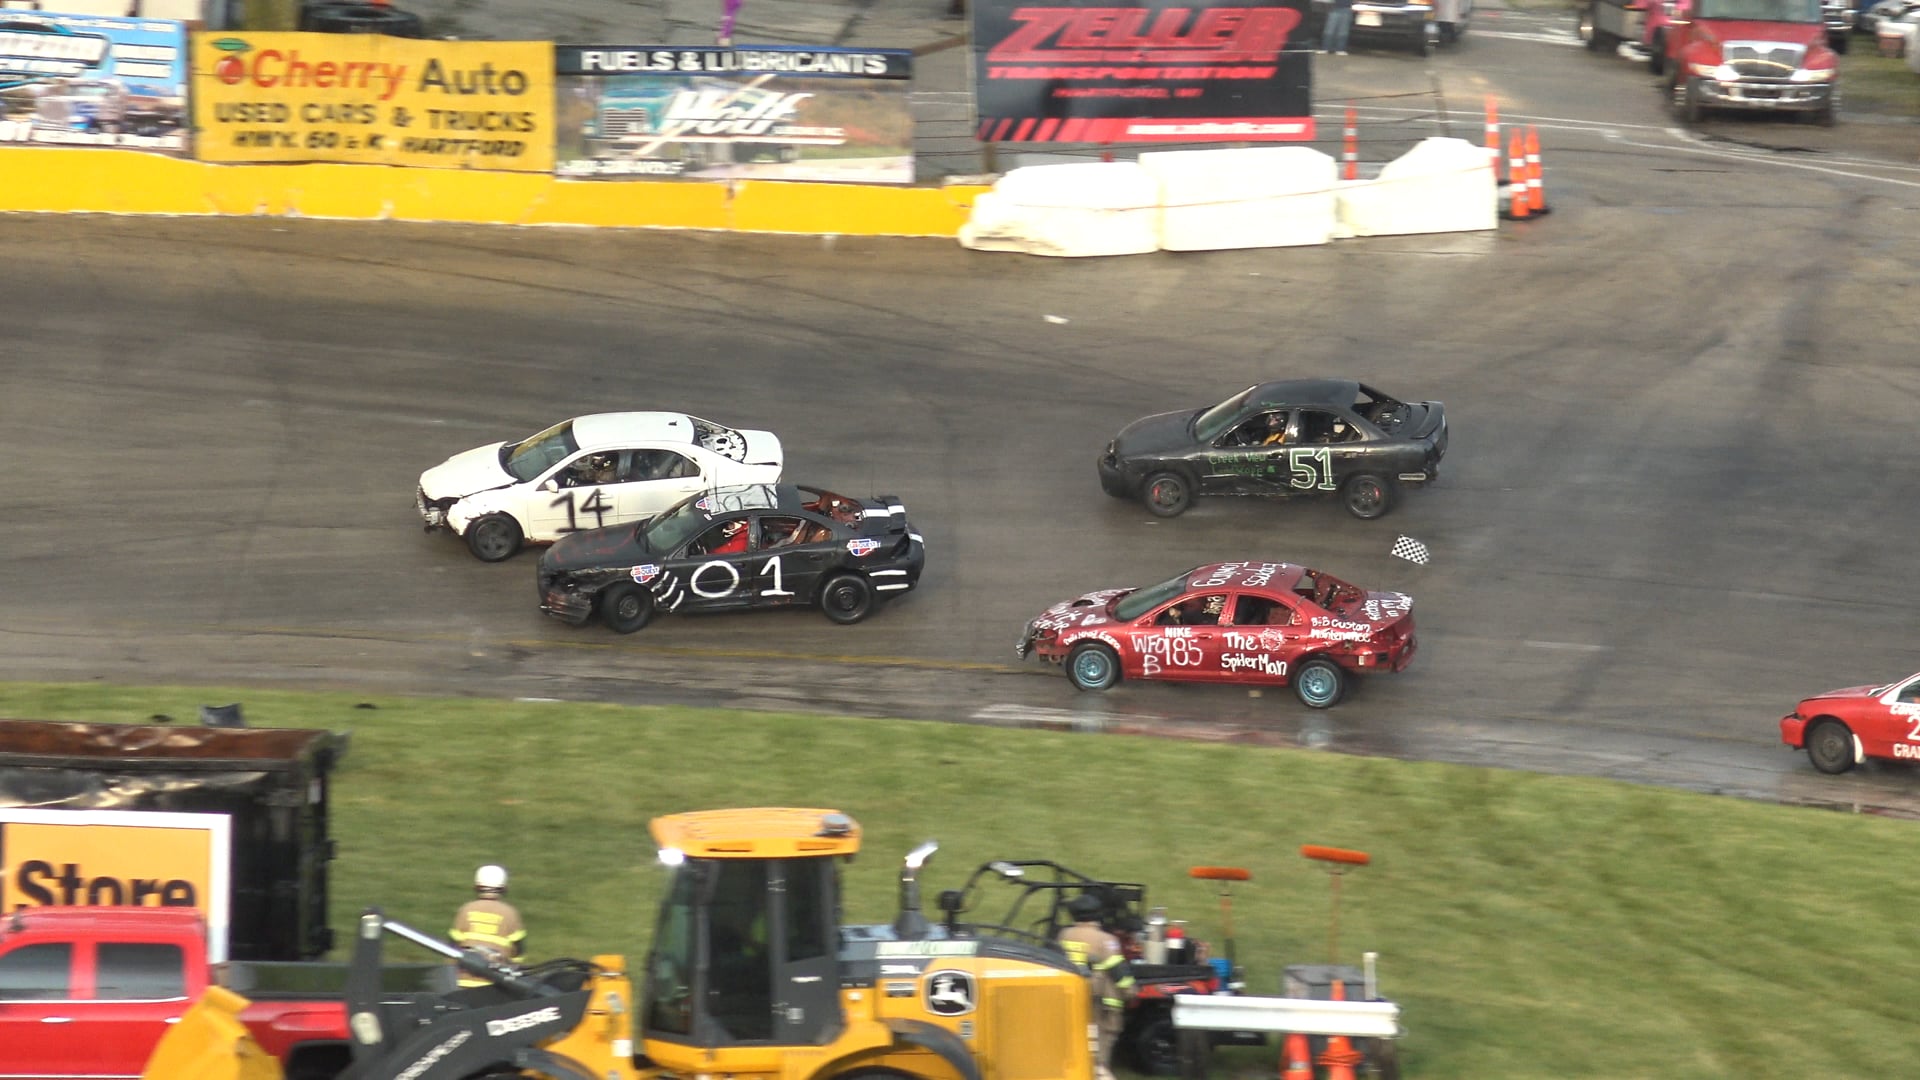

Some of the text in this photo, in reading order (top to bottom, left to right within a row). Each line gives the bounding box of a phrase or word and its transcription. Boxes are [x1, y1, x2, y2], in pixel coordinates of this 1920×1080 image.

[986, 8, 1301, 61] ZELLER
[252, 49, 528, 100] Cherry Auto
[581, 51, 888, 74] FUELS & LUBRICANTS
[987, 66, 1278, 80] TRANSPORTATION
[214, 102, 537, 132] USED CARS & TRUCKS
[306, 130, 340, 149] 60
[401, 136, 527, 157] HARTFORD
[1289, 447, 1336, 491] 51
[550, 488, 613, 534] 14
[1164, 627, 1192, 639] NIKE
[1221, 630, 1259, 651] The
[1143, 654, 1163, 676] B
[18, 860, 197, 907] Store
